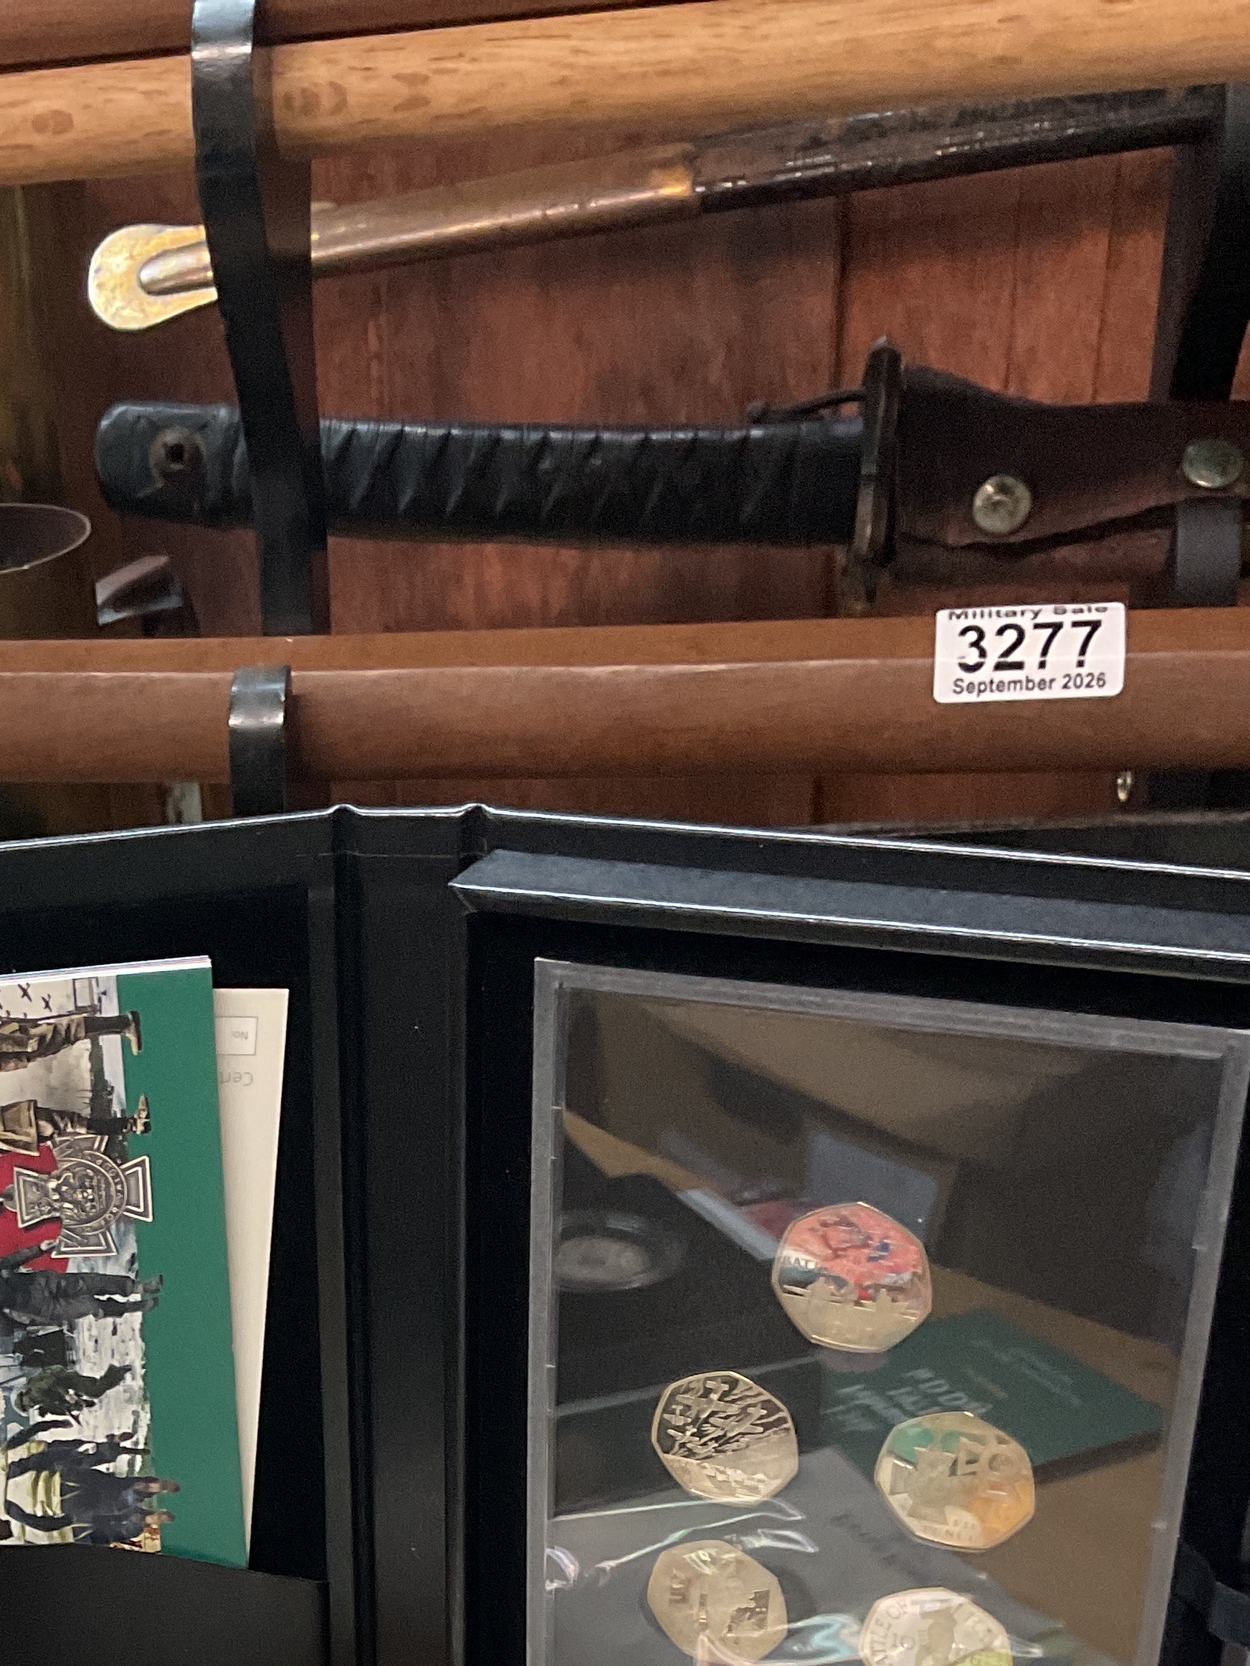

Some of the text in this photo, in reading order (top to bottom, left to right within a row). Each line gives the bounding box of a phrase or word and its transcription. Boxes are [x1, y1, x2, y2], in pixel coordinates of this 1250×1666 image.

[949, 605, 1109, 622] Military Sale
[957, 620, 1103, 674] 3277
[952, 672, 1107, 697] September 2026
